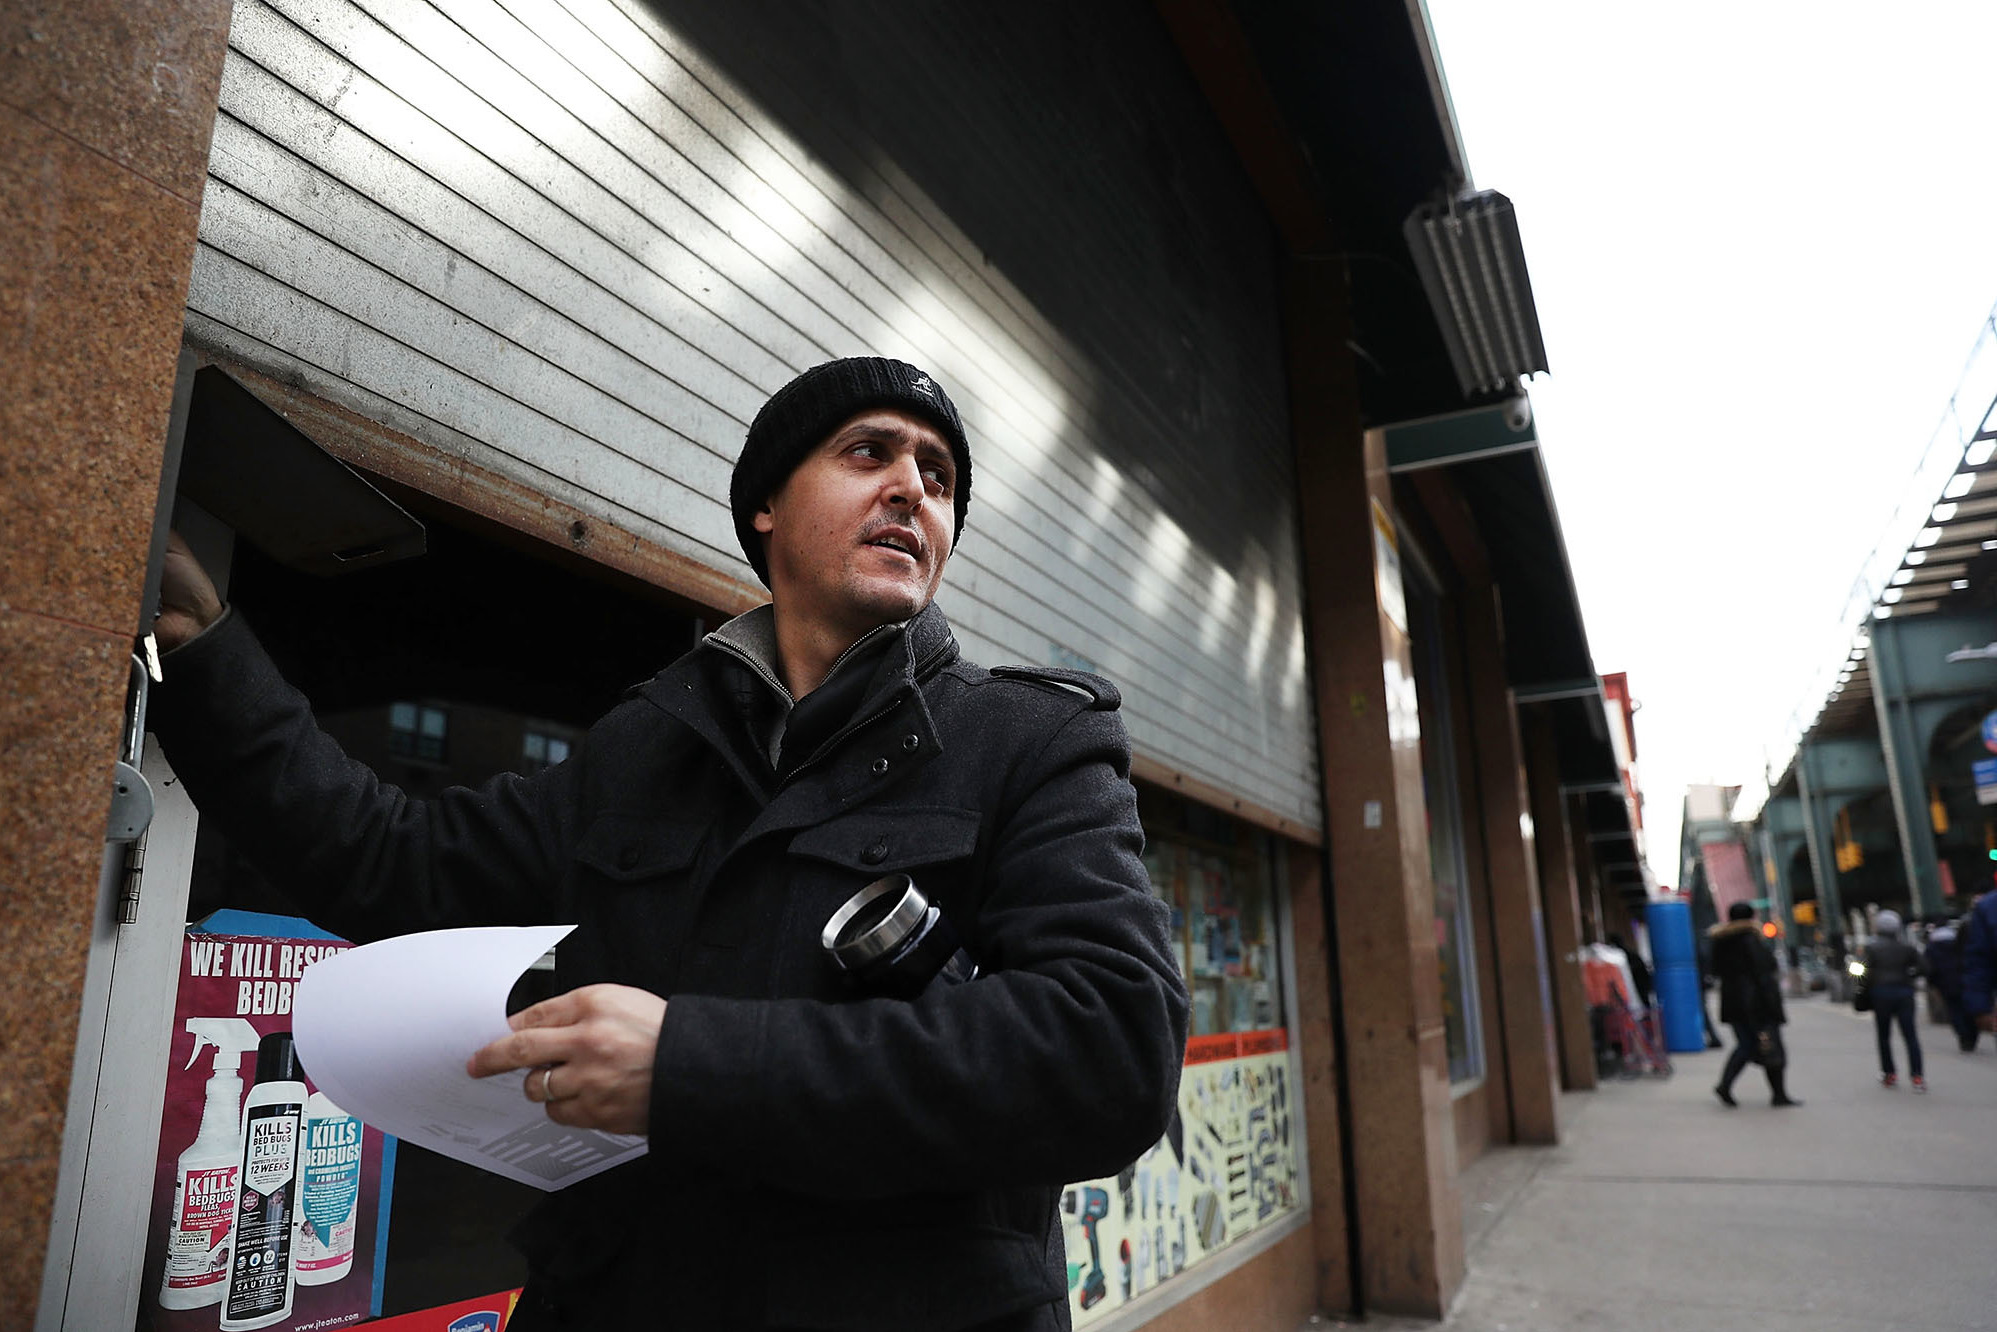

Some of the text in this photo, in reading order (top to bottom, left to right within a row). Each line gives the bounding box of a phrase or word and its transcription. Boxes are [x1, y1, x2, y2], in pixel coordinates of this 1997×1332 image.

[190, 941, 225, 977] WE
[229, 943, 274, 978] KILL
[254, 1122, 292, 1137] KILLS
[312, 1122, 356, 1148] KILLS
[253, 1134, 292, 1146] BED BUGS
[254, 1143, 287, 1157] PLUS
[305, 1143, 360, 1167] BEDBUGS
[250, 1162, 290, 1174] 12 WEEKS
[188, 1173, 238, 1196] KILLS
[188, 1190, 236, 1206] BEDBUGS
[236, 1277, 282, 1291] CAUTION
[294, 1312, 360, 1332] www.jteaton.com
